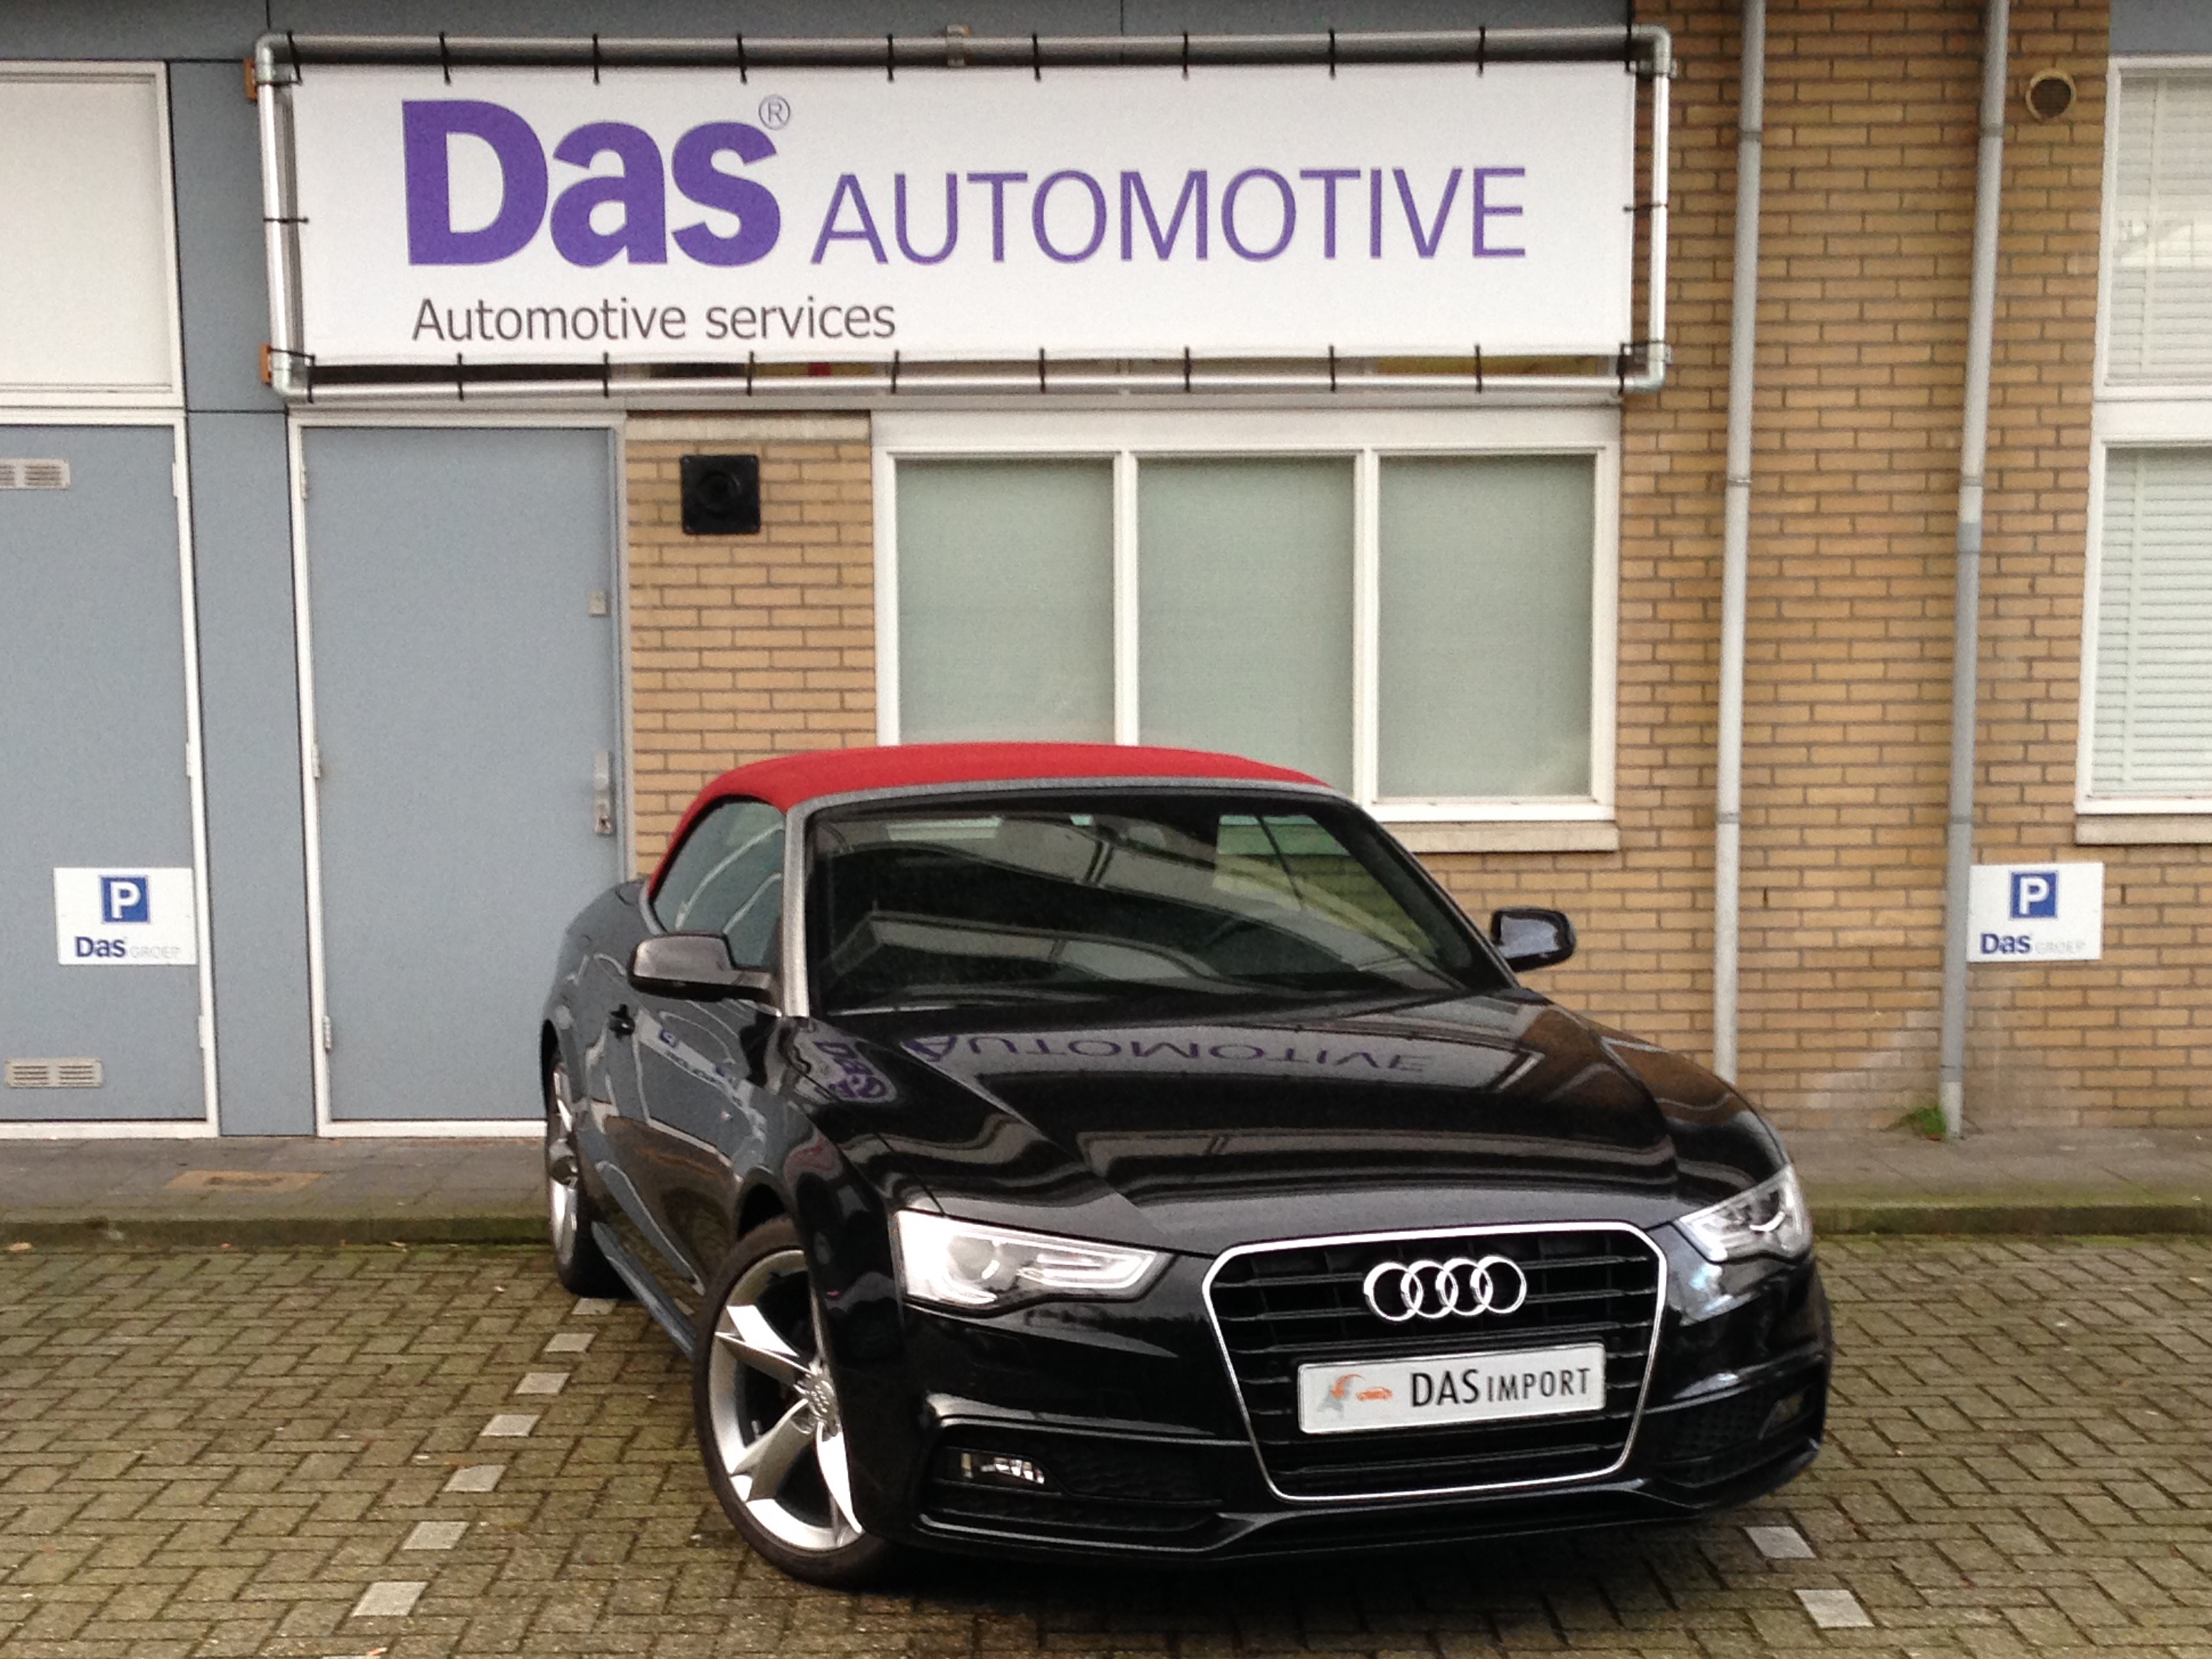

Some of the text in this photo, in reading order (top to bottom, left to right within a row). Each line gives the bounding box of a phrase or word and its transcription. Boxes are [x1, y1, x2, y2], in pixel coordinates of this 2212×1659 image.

[811, 167, 1526, 265] AUTOMOTIVE
[411, 296, 897, 341] Automotive services
[110, 882, 141, 919] P
[2019, 877, 2050, 915] P
[75, 936, 126, 958] Das
[1980, 933, 2032, 954] Das
[1410, 1368, 1591, 1408] DAS IMPORT
